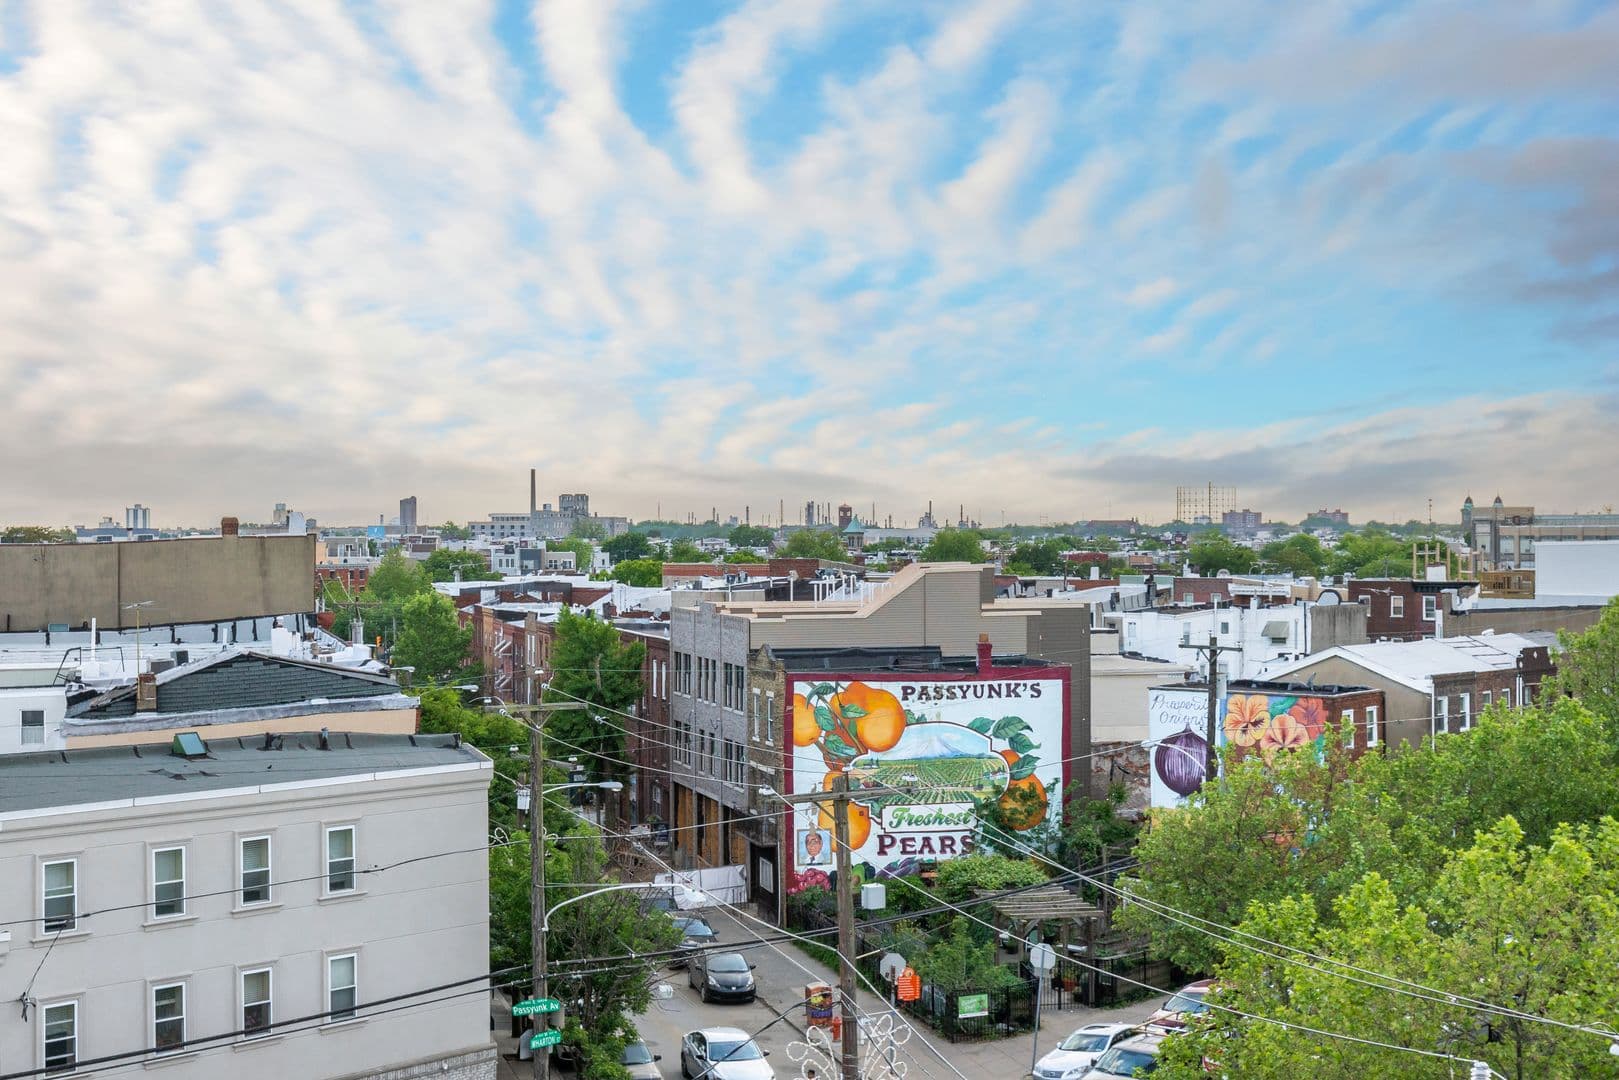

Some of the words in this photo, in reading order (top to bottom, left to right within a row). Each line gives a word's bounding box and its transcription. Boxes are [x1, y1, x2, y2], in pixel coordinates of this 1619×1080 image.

[901, 683, 1042, 701] PASSYUNK'S
[1160, 711, 1205, 727] Onions
[888, 807, 972, 828] Freshest
[877, 834, 975, 856] PEARS
[513, 1003, 546, 1016] Passyunk
